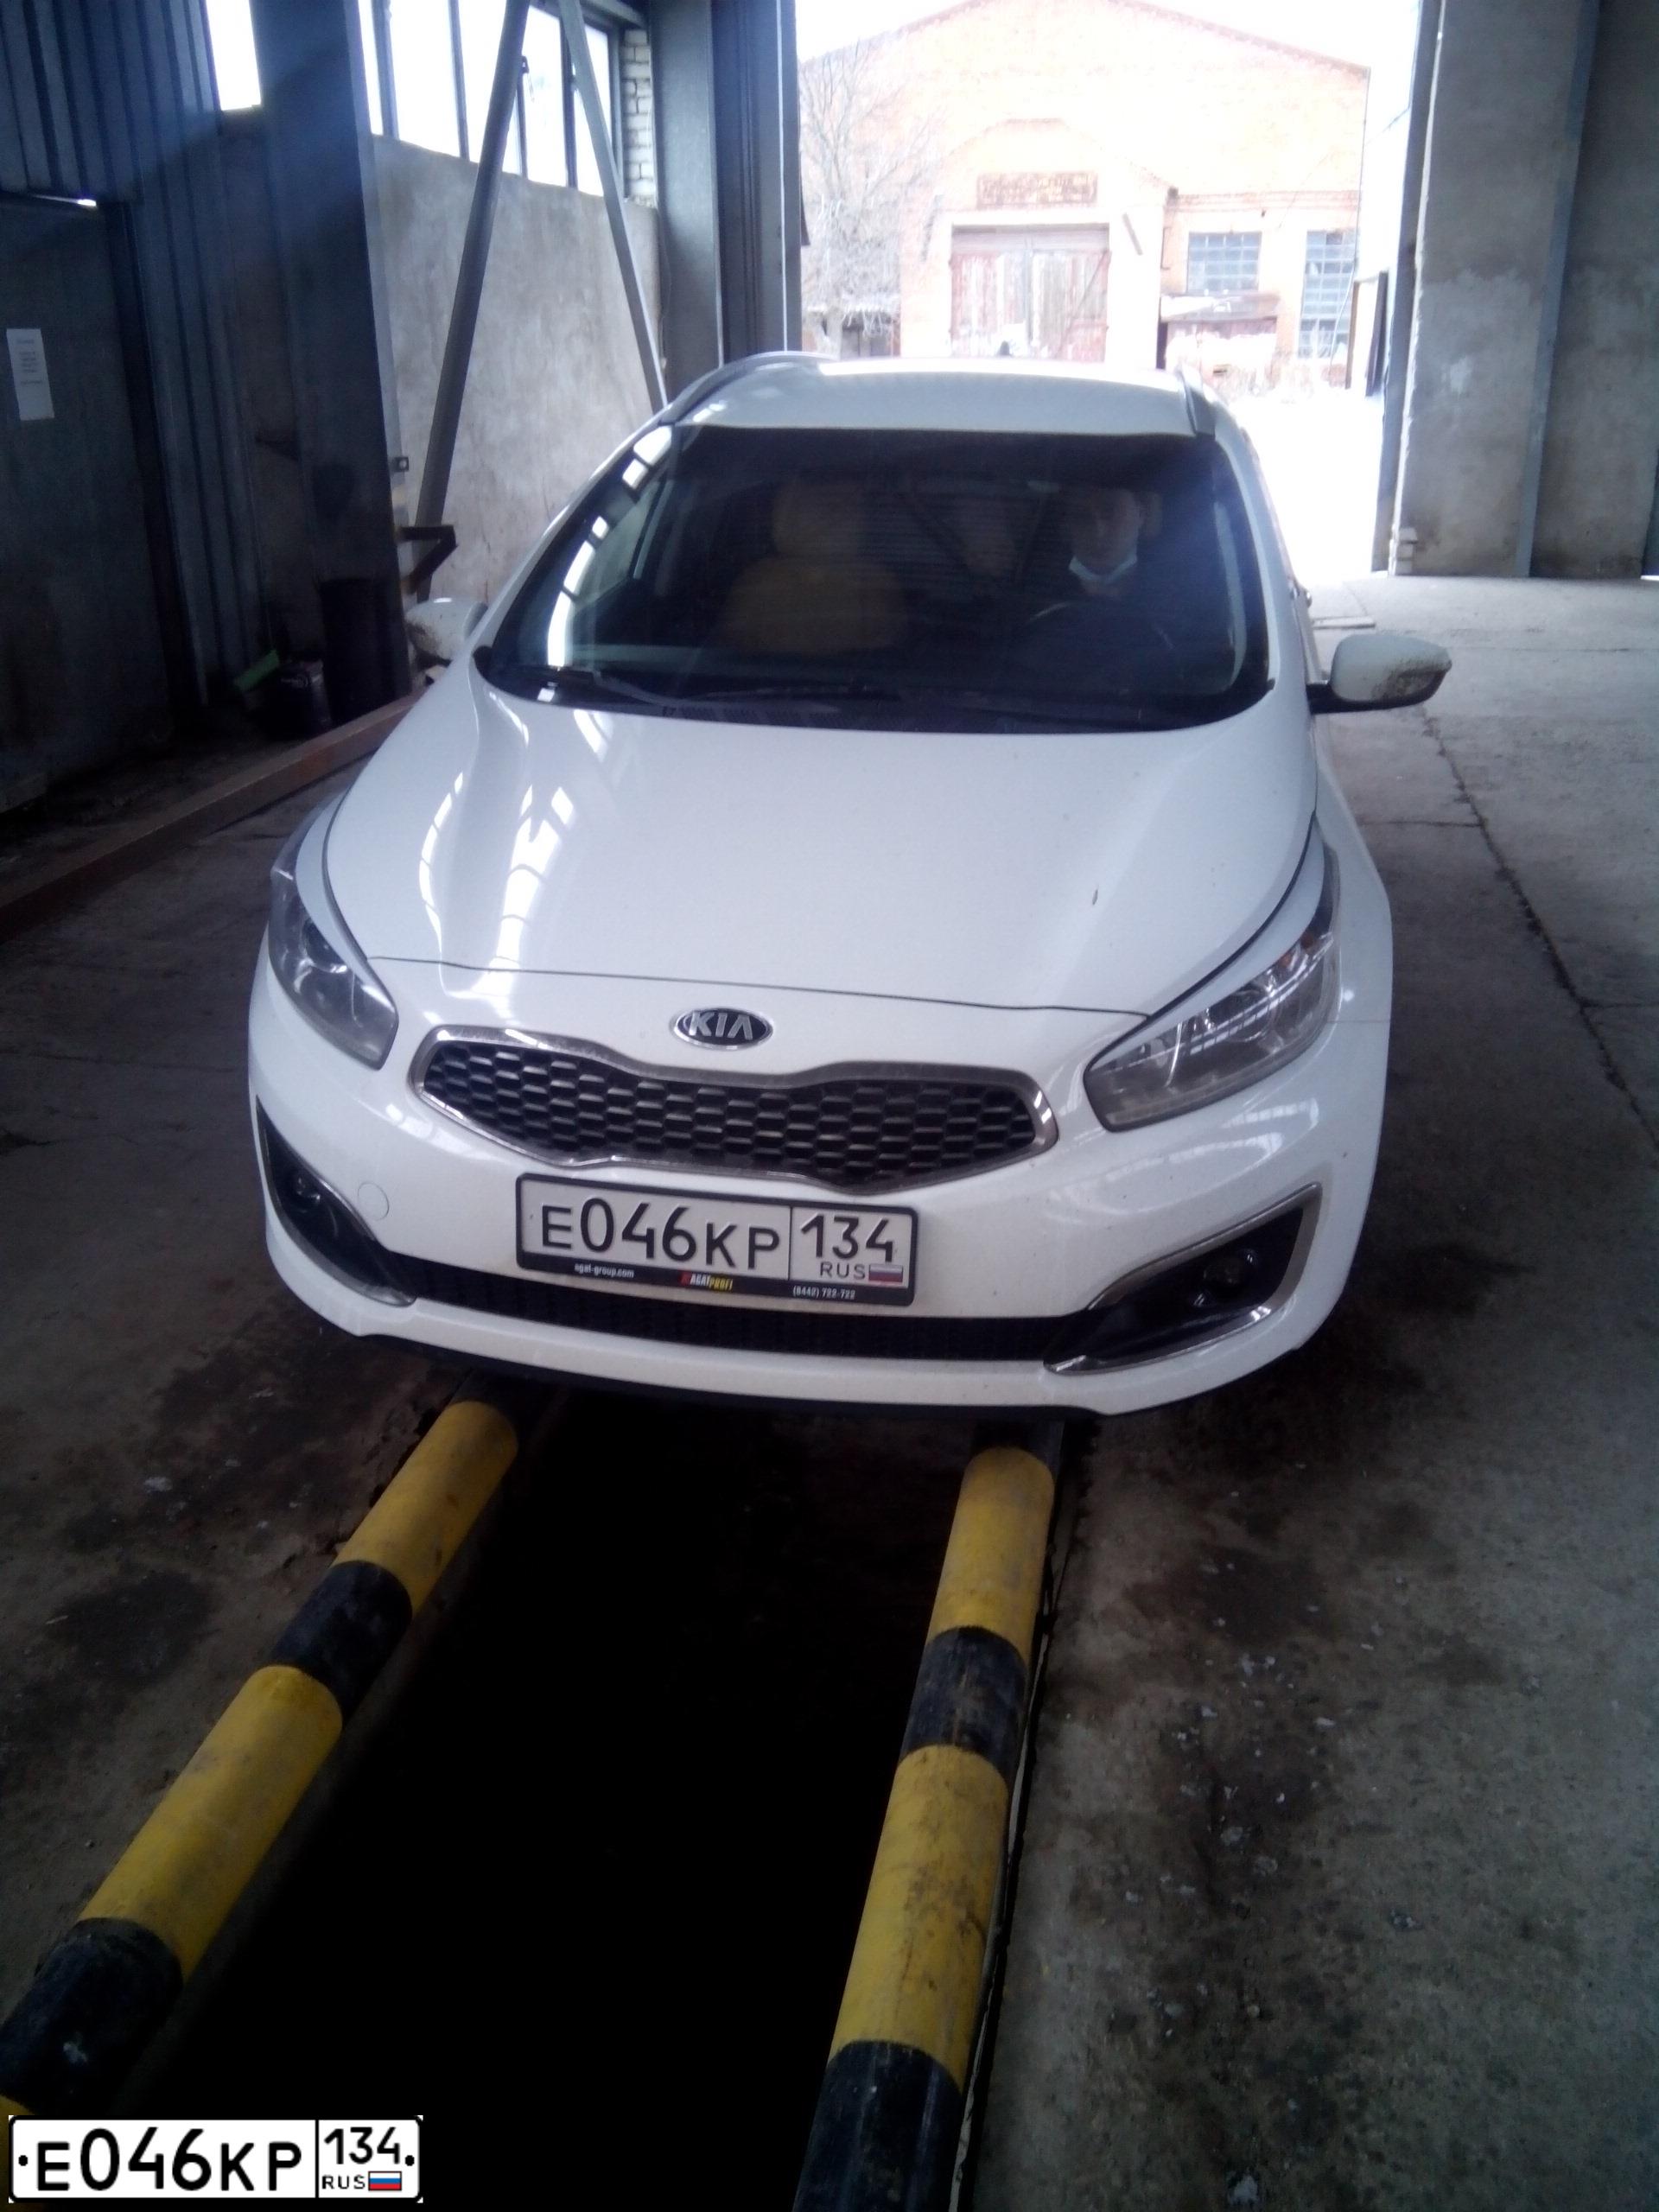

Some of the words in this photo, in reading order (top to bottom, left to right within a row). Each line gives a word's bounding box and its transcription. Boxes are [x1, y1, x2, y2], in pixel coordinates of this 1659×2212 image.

[689, 1011, 753, 1040] KIA
[801, 1214, 894, 1262] 134
[820, 1262, 866, 1281] RUS
